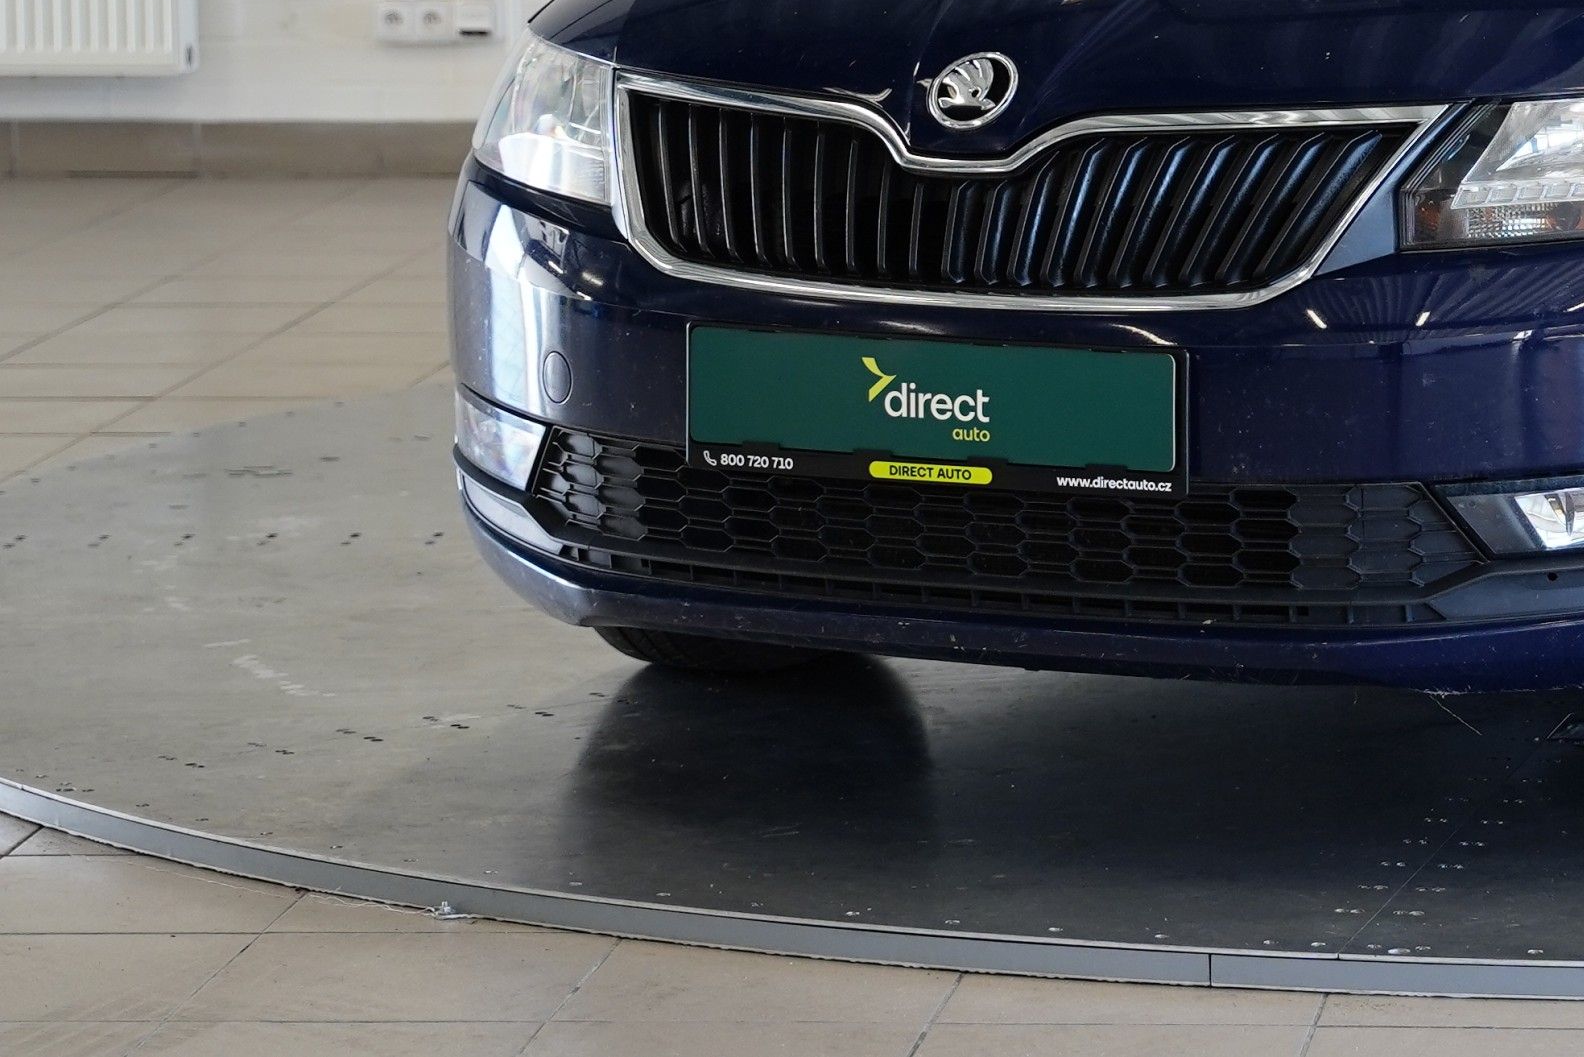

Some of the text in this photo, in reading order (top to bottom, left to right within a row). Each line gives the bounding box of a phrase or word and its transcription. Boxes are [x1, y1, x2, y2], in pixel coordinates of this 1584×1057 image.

[884, 382, 990, 423] direct
[952, 426, 991, 442] auto
[720, 453, 794, 470] 800 720 710
[889, 465, 972, 480] DIRECT AUTO
[1056, 476, 1172, 492] www.directauto.cz
